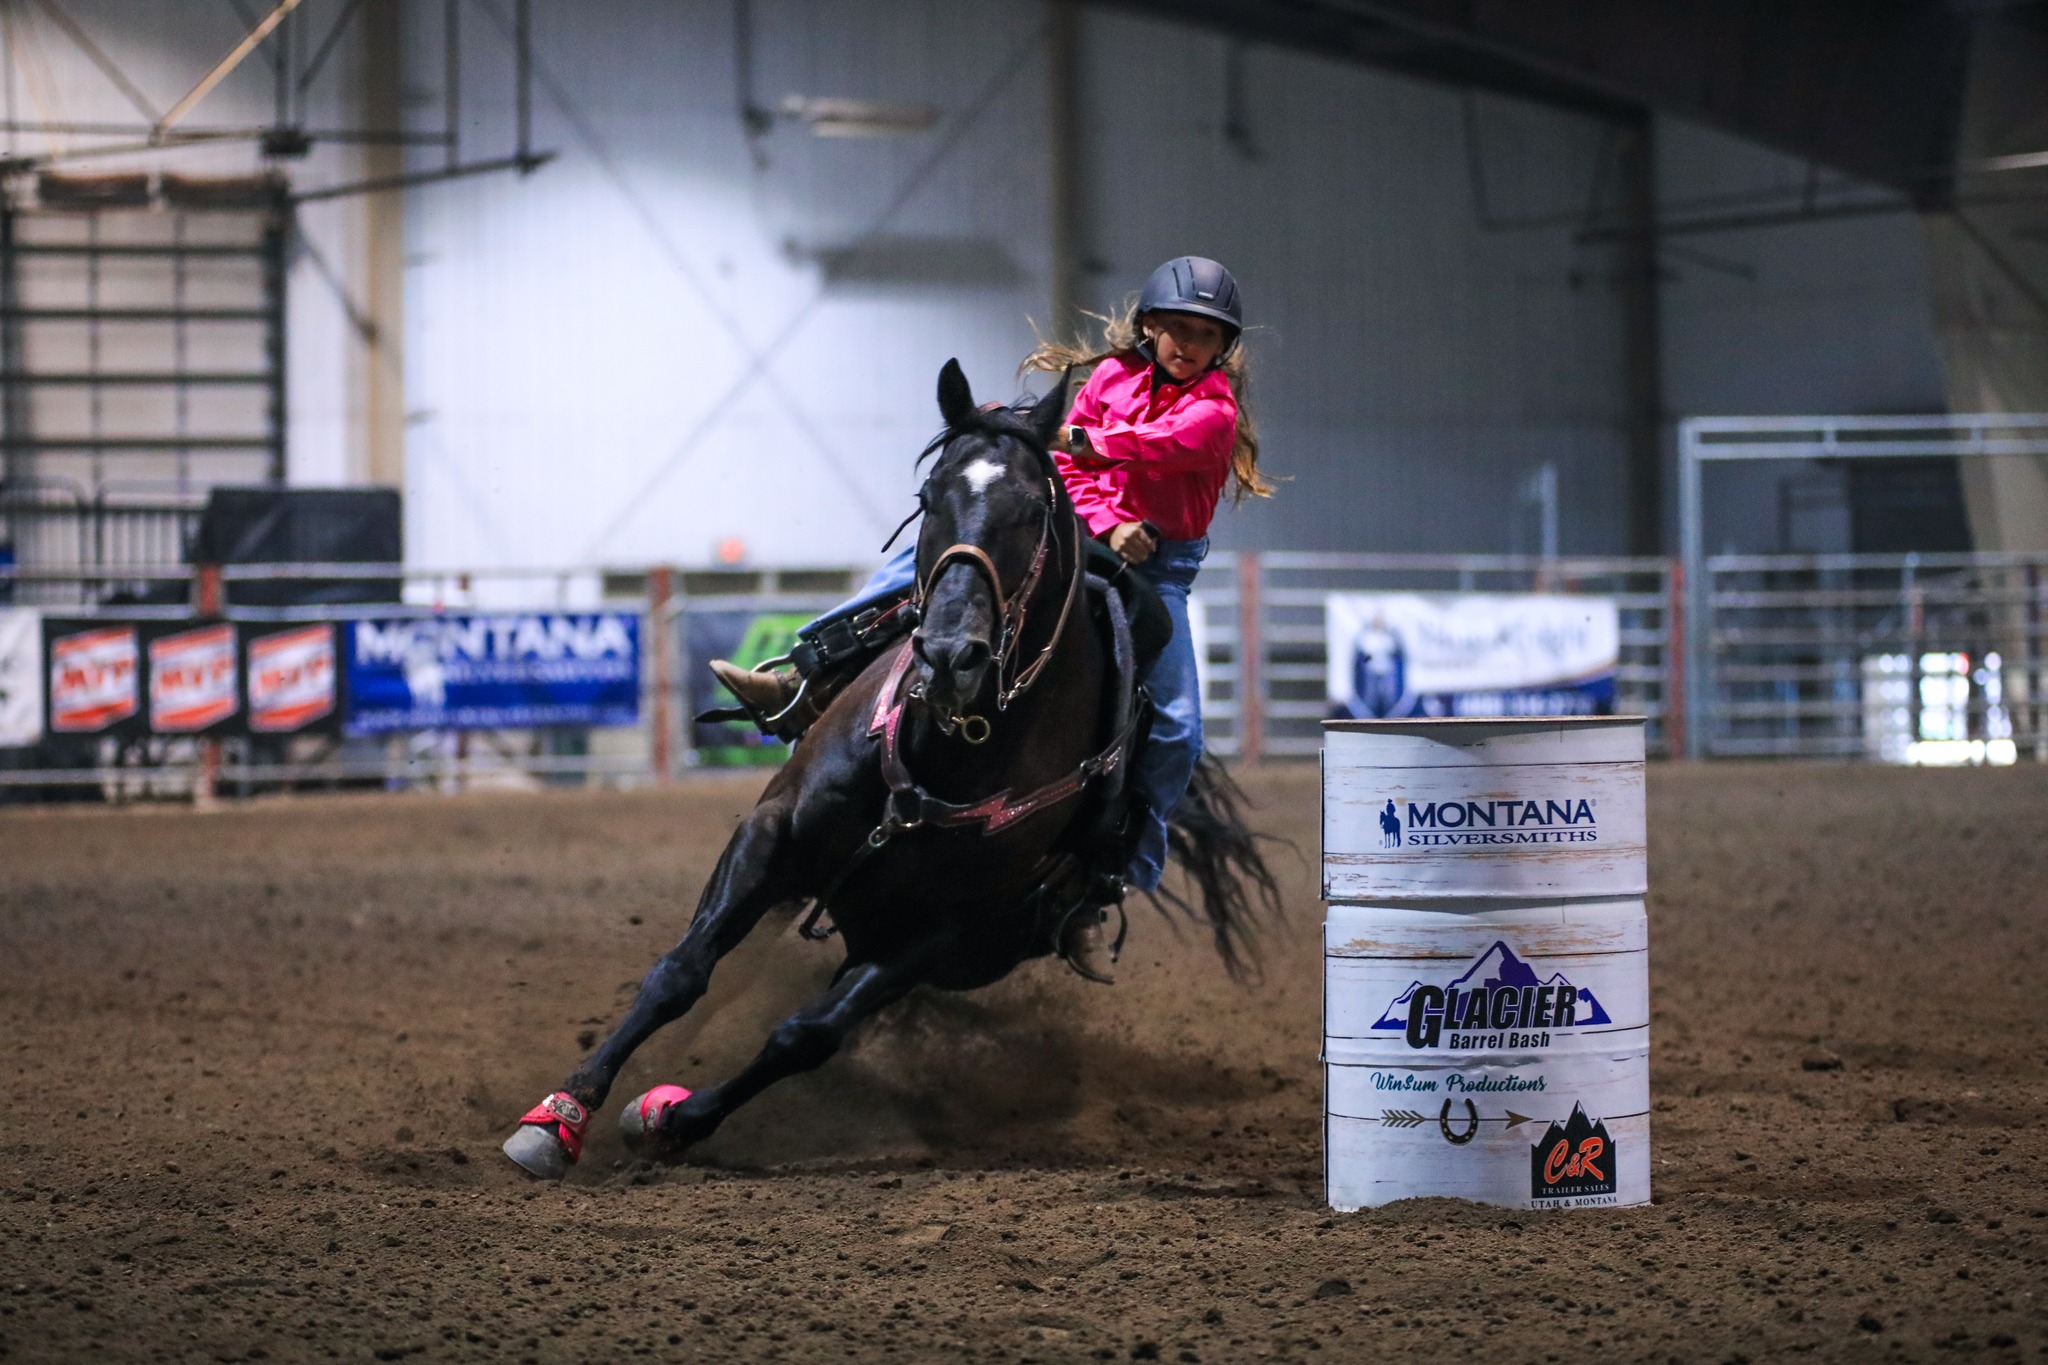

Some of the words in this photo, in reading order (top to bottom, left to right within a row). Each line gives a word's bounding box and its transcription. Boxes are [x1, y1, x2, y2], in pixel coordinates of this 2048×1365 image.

[1408, 831, 1597, 846] SILVERSMITHS
[1406, 985, 1578, 1049] GLACIER
[1449, 1033, 1504, 1049] Barrel
[1509, 1032, 1550, 1049] Bash
[1446, 1073, 1547, 1093] Productions
[1543, 1136, 1604, 1184] C&R
[1542, 1186, 1582, 1194] TRAILER
[1531, 1199, 1560, 1209] UTAH
[1564, 1199, 1571, 1207] &
[1574, 1196, 1617, 1206] MONTANA
